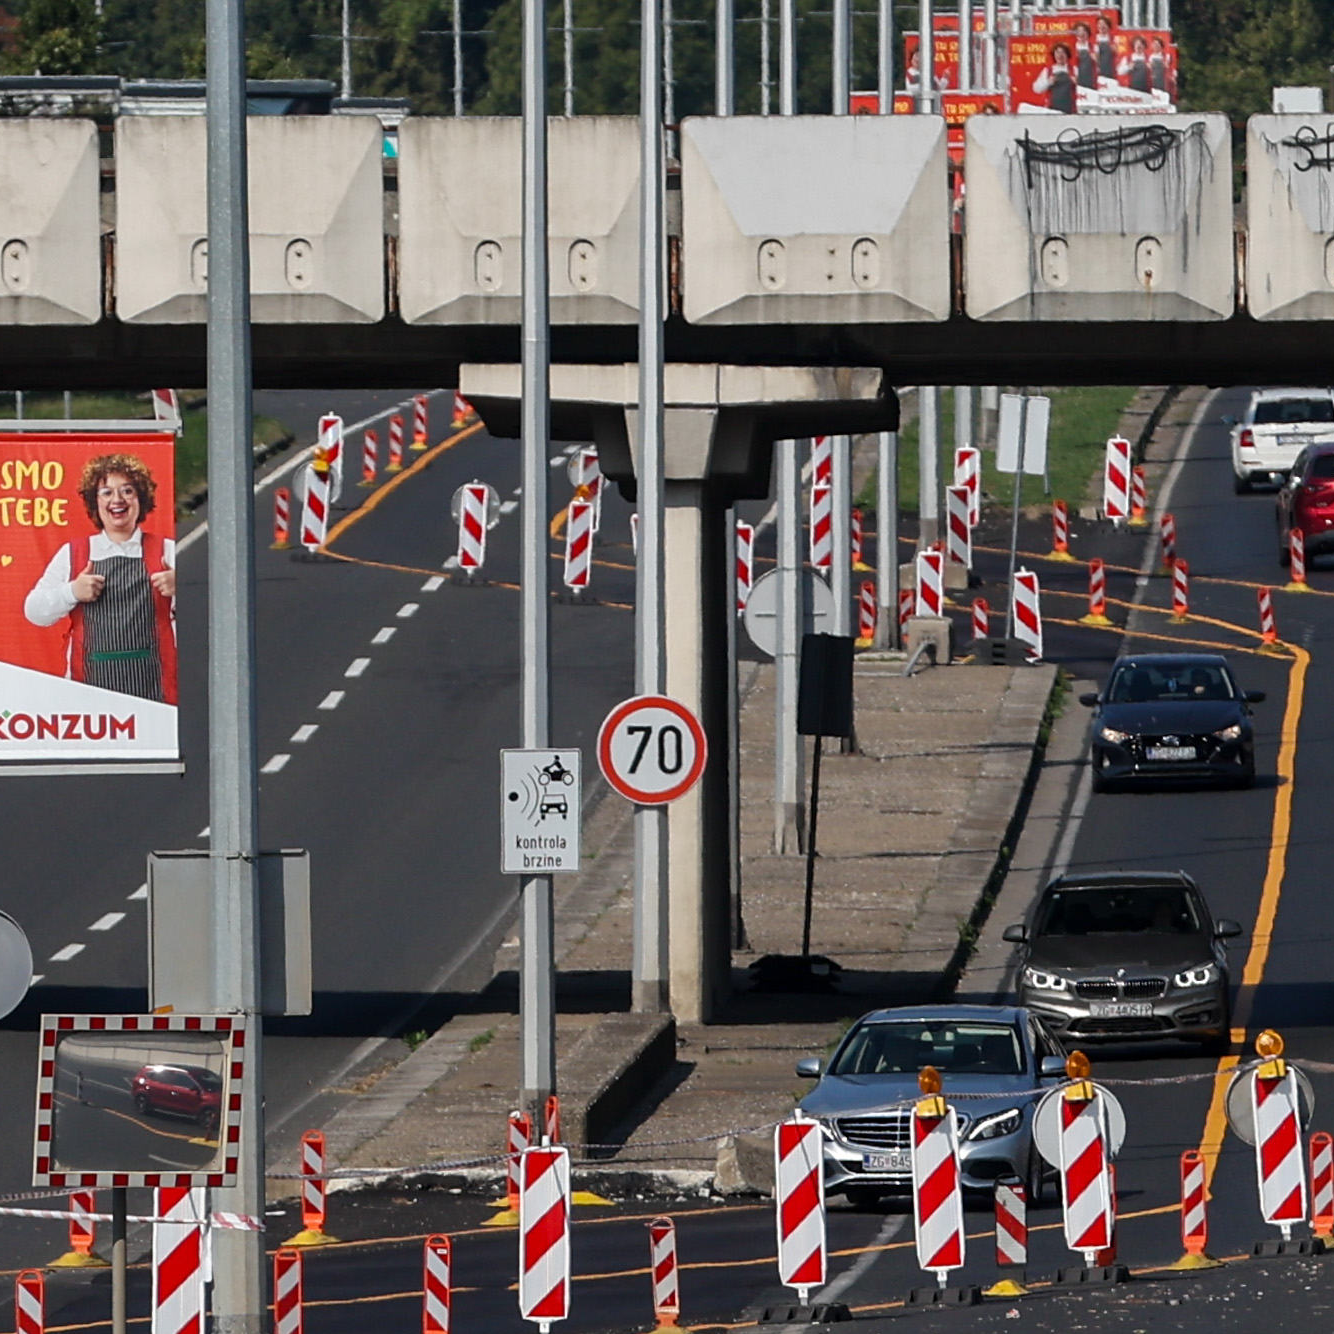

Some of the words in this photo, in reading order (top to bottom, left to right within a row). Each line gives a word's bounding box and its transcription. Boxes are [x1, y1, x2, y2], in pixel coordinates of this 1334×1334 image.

[0, 460, 64, 491] SMO
[626, 725, 683, 775] 70
[516, 835, 567, 849] kontrola
[523, 854, 562, 868] brzine
[871, 1156, 885, 1168] ZG
